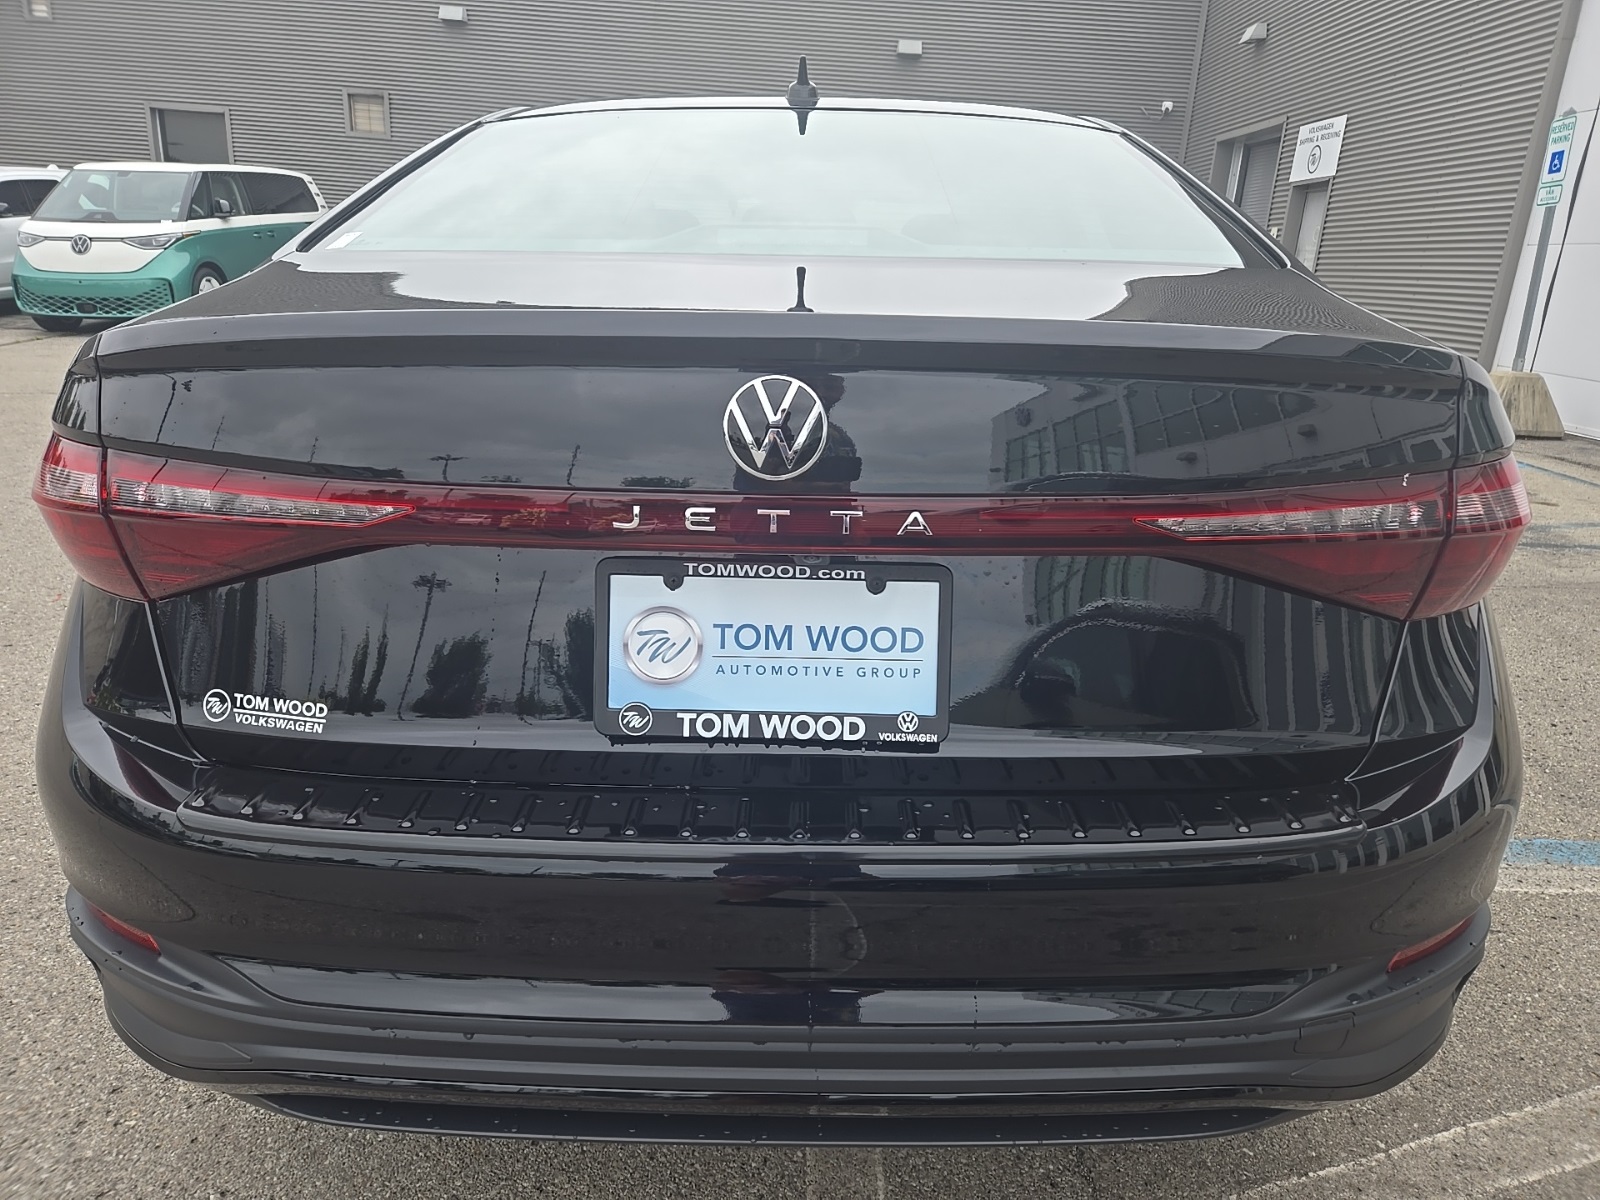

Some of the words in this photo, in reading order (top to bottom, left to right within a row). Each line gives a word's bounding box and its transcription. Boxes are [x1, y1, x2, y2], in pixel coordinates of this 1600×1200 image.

[1551, 121, 1575, 134] RESERVED
[1551, 133, 1571, 146] PARKING
[613, 505, 933, 536] JETTA
[684, 562, 866, 580] TOMWOOD.com
[712, 623, 793, 652] TOM
[805, 625, 925, 653] WOOD
[715, 664, 844, 678] AUTOMOTIVE
[856, 666, 921, 679] GROUP
[234, 693, 269, 711] TOM
[273, 698, 328, 717] WOOD
[235, 713, 323, 733] VOLKSWAGEN
[677, 712, 750, 738] TOM
[759, 714, 866, 741] WOOD
[878, 732, 938, 742] VOLKSWAGEN
